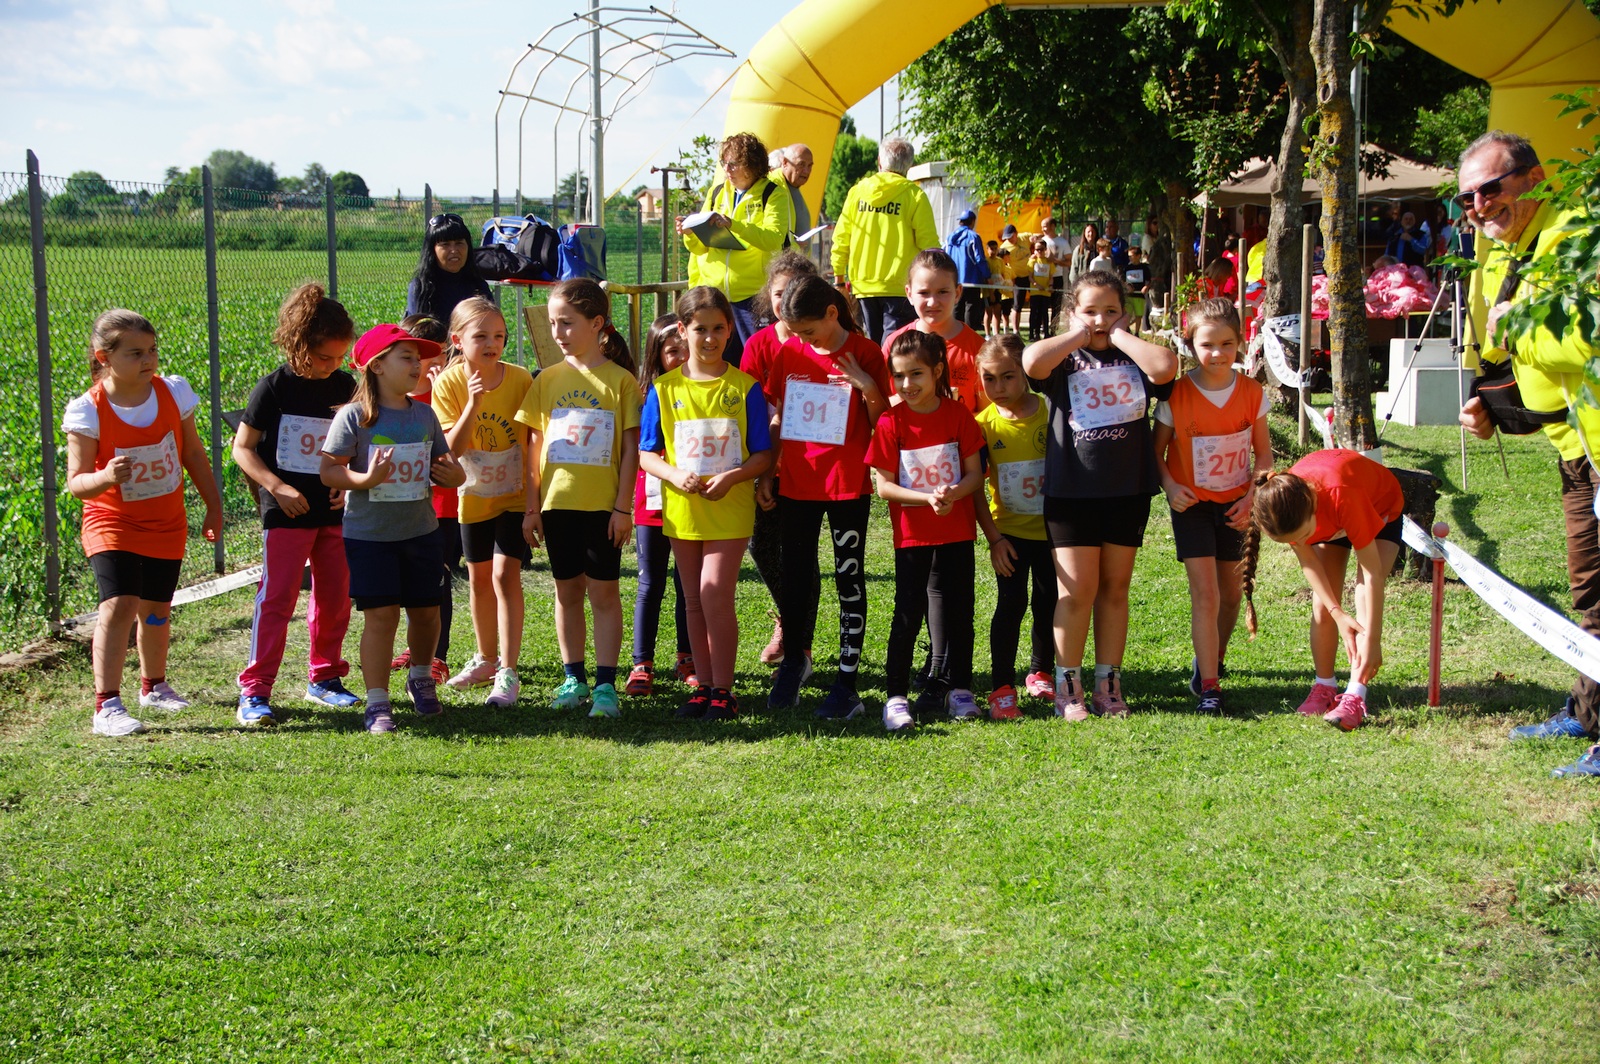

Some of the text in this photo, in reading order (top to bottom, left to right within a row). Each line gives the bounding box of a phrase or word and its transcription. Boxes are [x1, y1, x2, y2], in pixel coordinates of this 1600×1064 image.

[556, 390, 603, 410] ETICAIM
[1084, 382, 1134, 409] 352
[802, 400, 827, 423] 91
[565, 425, 595, 446] 57
[686, 435, 730, 459] 257
[132, 453, 174, 483] 253
[383, 459, 425, 484] 292
[1208, 447, 1247, 476] 270
[480, 464, 507, 484] 58
[909, 461, 955, 489] 263
